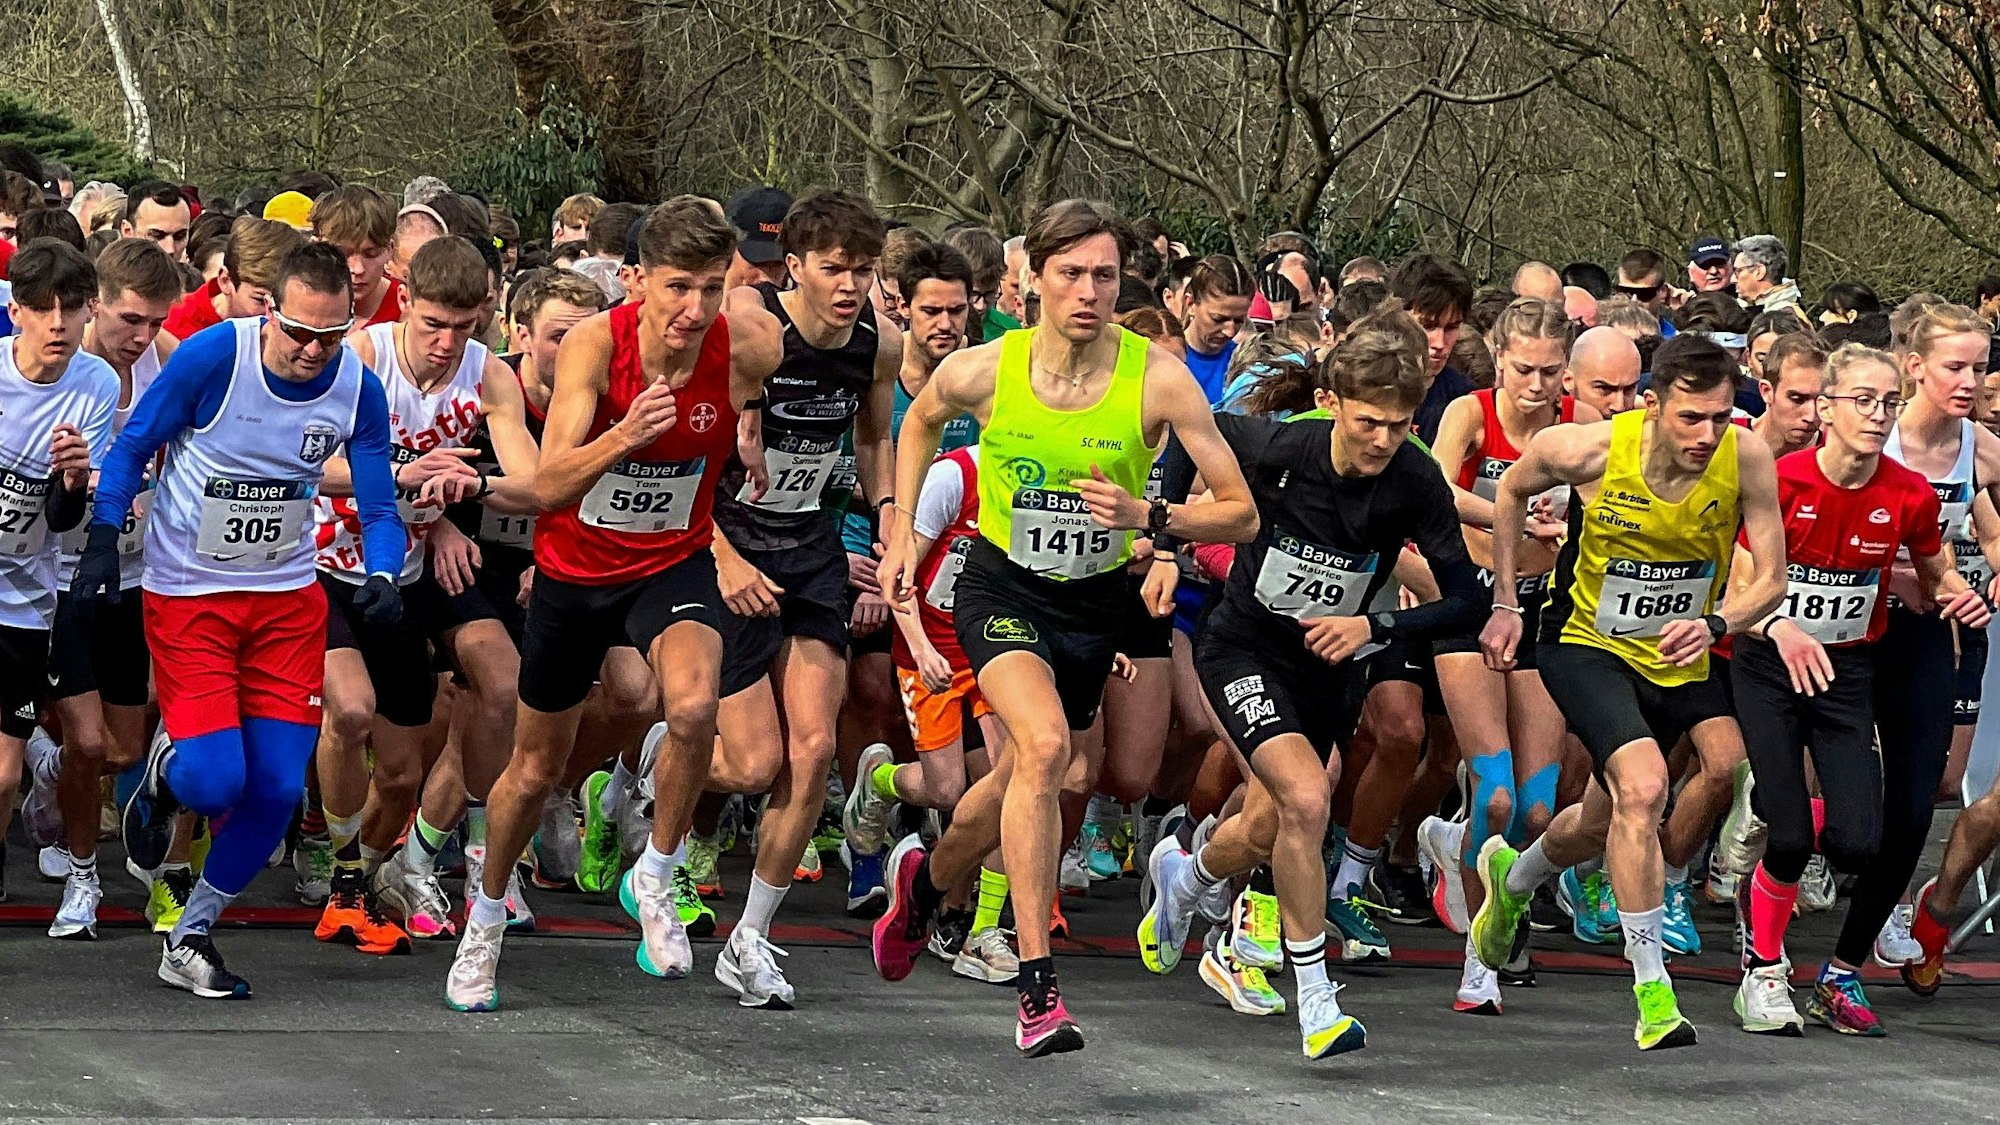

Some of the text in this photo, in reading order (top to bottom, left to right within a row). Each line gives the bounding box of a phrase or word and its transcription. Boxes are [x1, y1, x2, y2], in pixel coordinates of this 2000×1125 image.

[799, 440, 834, 454] Bayer
[1080, 437, 1123, 451] SC MYHL
[628, 462, 680, 478] Bayer
[3, 472, 49, 497] Bayer
[635, 480, 660, 489] Tom
[774, 469, 820, 492] 126
[0, 492, 37, 508] Marten
[237, 483, 287, 501] Bayer
[1936, 488, 1953, 500] er
[229, 503, 285, 514] Christoph
[609, 489, 674, 514] 592
[1047, 493, 1091, 512] Baye
[0, 506, 41, 535] 27
[1051, 515, 1089, 527] Jonas
[1598, 511, 1642, 531] infinex
[223, 517, 282, 544] 305
[1027, 528, 1110, 556] 1415
[1954, 544, 1980, 558] ayer
[1301, 544, 1353, 570] Bayer
[1297, 563, 1343, 581] Maurice
[1639, 564, 1690, 581] Bayer
[1807, 568, 1857, 585] Bayer
[1285, 573, 1345, 607] 749
[1616, 592, 1694, 620] 1688
[1786, 592, 1867, 621] 1812
